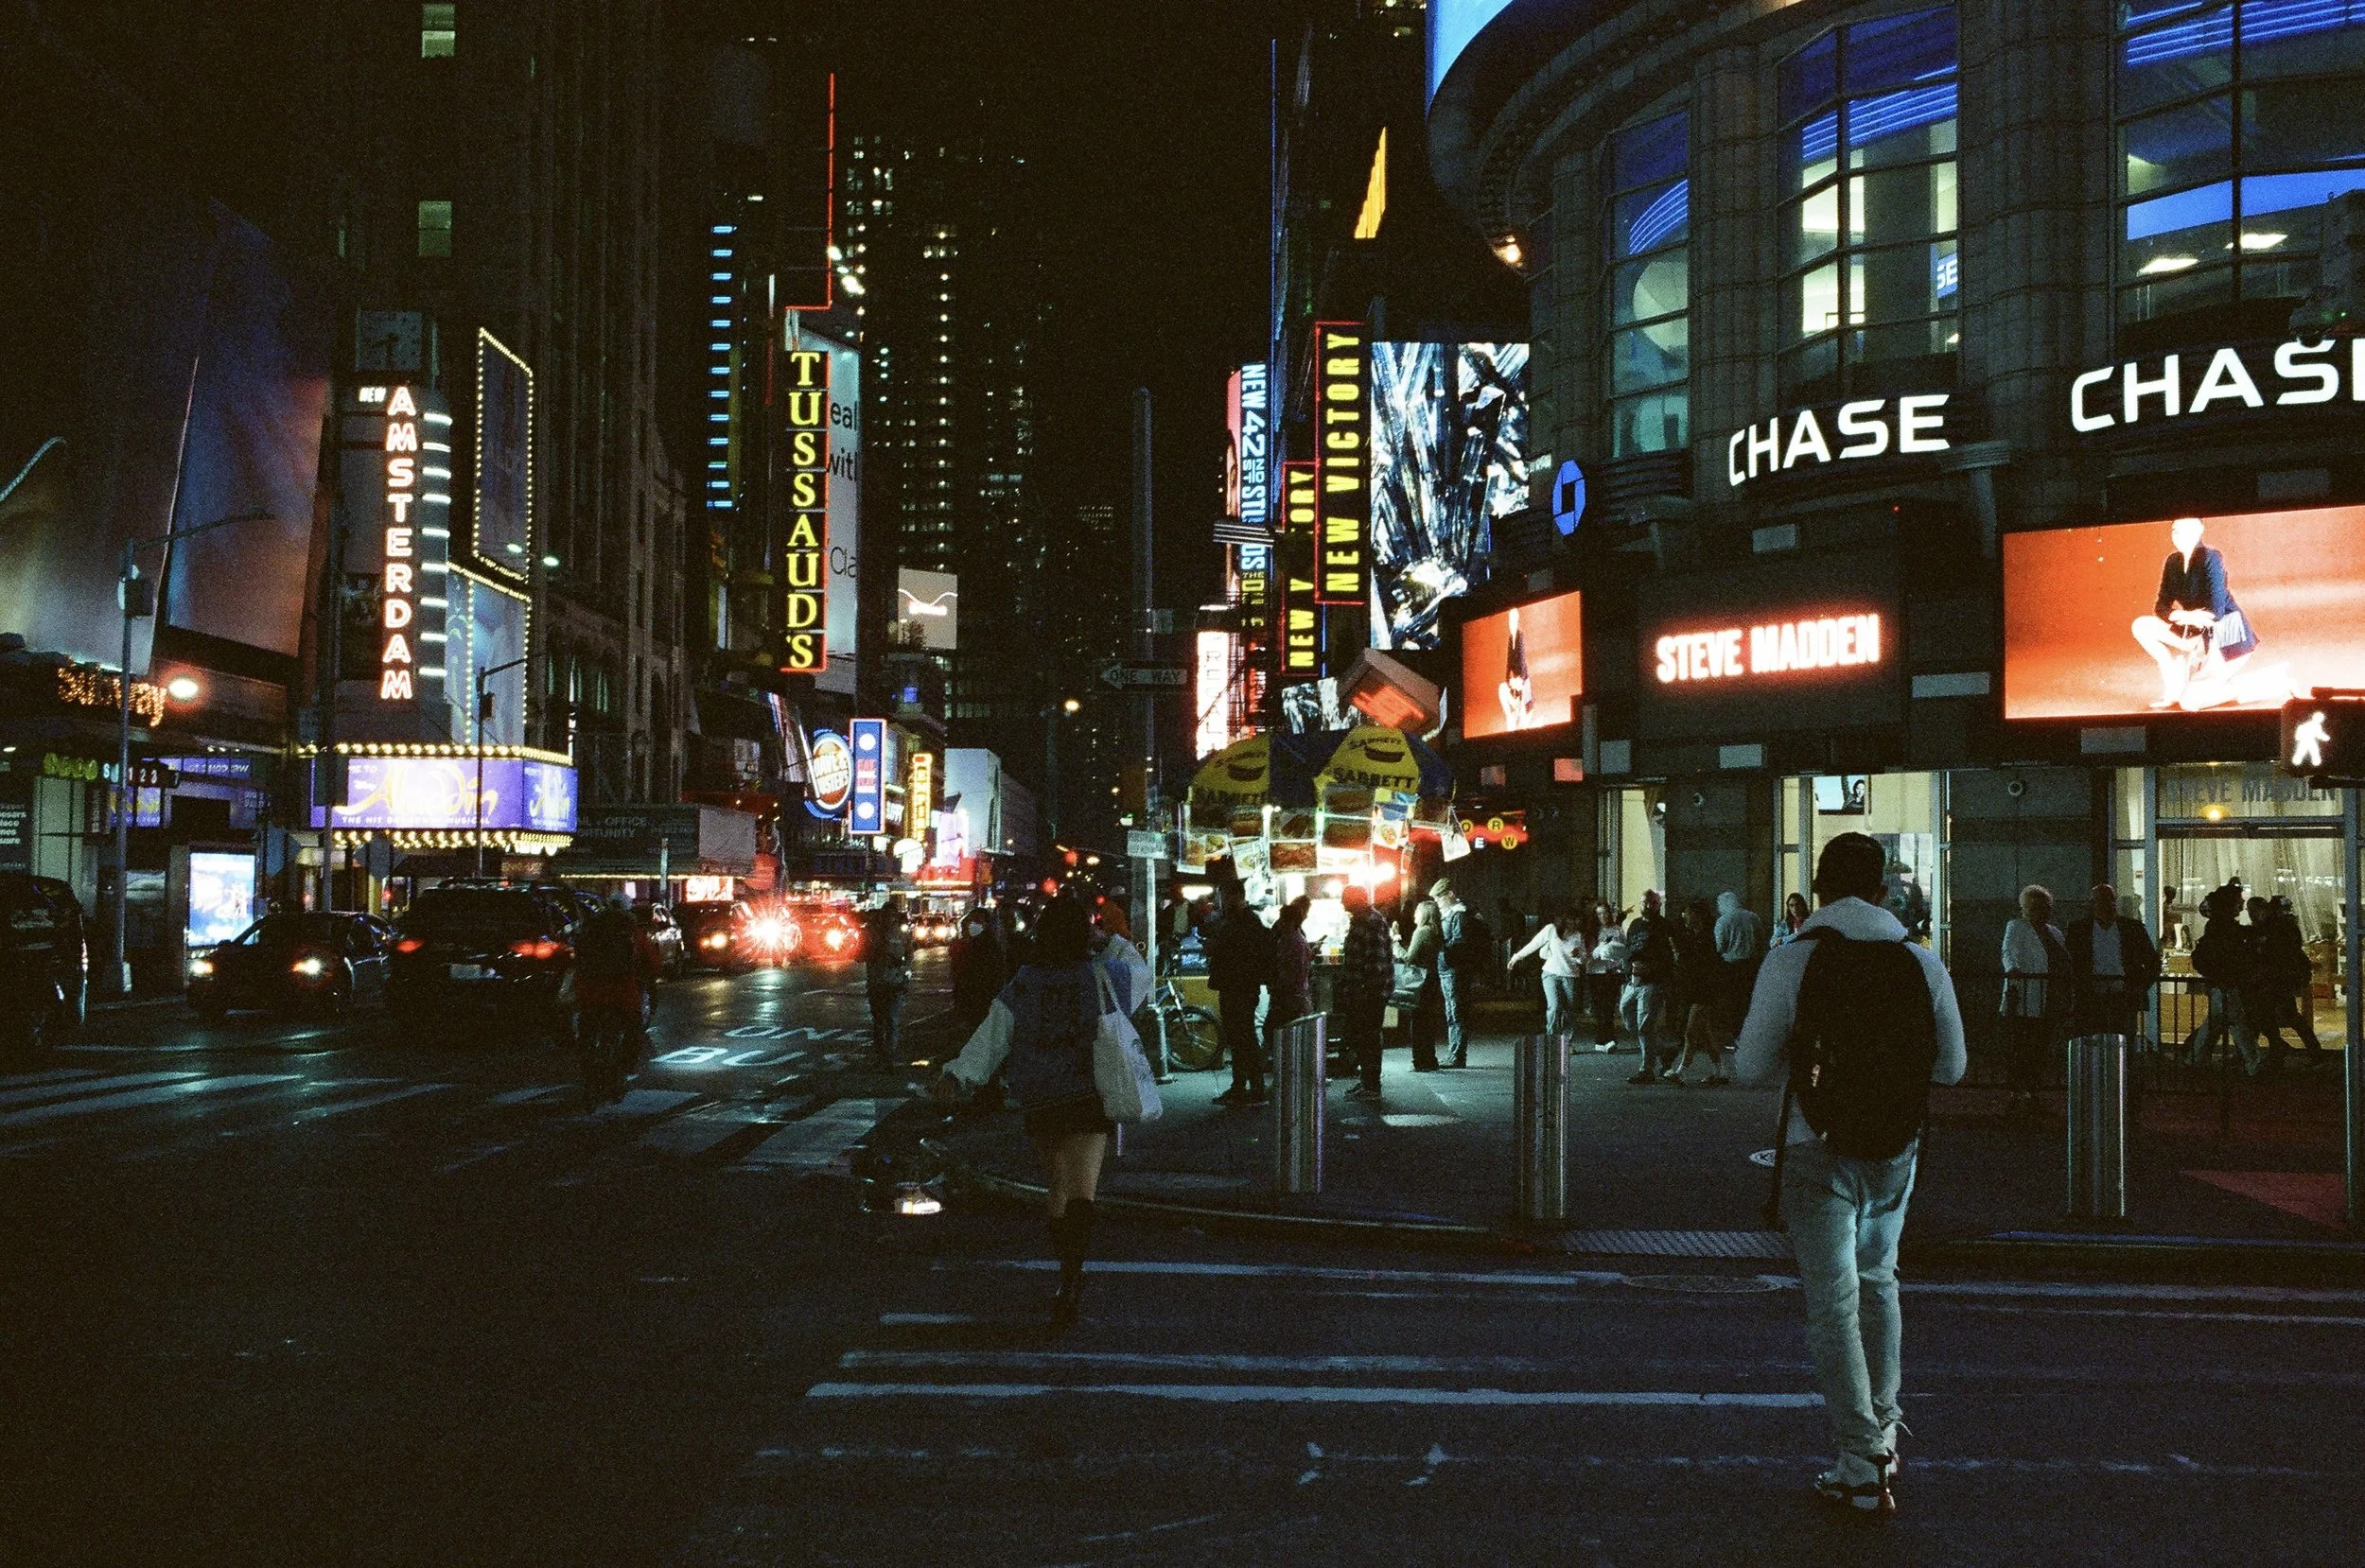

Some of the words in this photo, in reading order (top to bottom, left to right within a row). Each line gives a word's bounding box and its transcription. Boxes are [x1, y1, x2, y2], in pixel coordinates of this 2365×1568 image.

[359, 387, 386, 403] NEW
[1241, 364, 1266, 409] NEW
[1325, 331, 1360, 494] VICTORY
[1729, 394, 1951, 487] CHASE
[381, 386, 418, 700] AMSTERDAM
[786, 352, 821, 669] TUSSAUD'S
[1240, 486, 1266, 570] STUOS
[1289, 470, 1315, 592] VORY
[1326, 517, 1360, 592] NEW
[1289, 608, 1315, 669] NEW
[1656, 628, 1743, 684] STEVE
[1751, 613, 1880, 674] MADDEN
[1110, 670, 1137, 684] ONE
[1151, 670, 1181, 684] WAY
[1334, 767, 1416, 789] SABRETT
[2165, 777, 2232, 803] STEVE
[342, 816, 361, 825] THE
[1474, 836, 1485, 849] E
